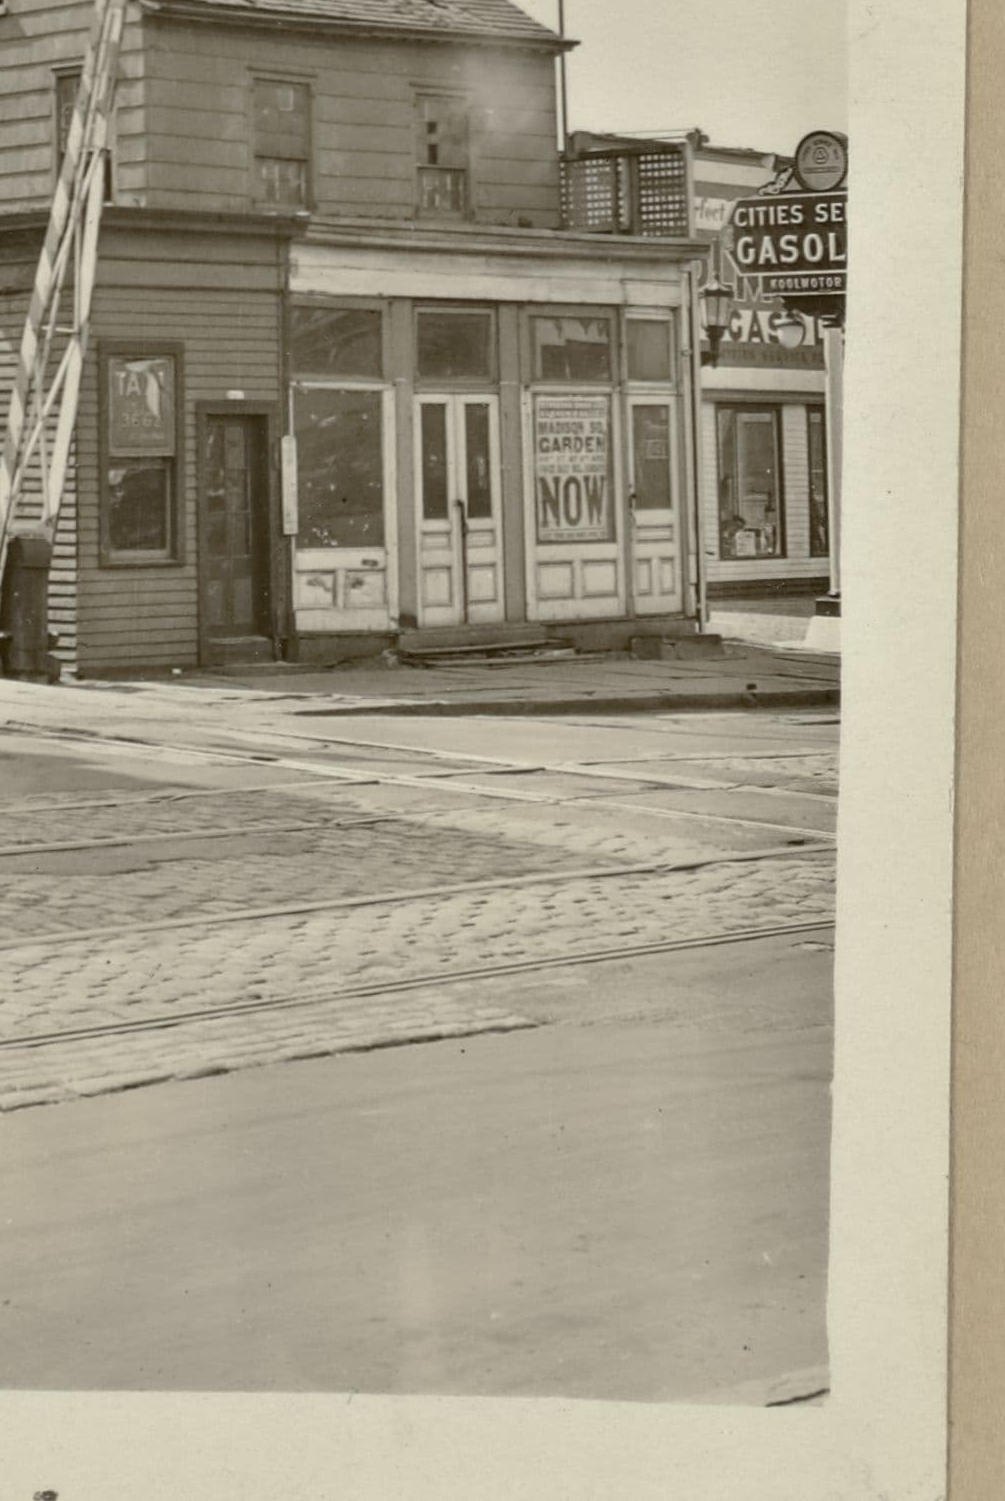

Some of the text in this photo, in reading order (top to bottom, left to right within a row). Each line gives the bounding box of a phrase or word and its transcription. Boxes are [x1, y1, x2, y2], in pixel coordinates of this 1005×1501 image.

[734, 204, 804, 227] CITIES
[736, 232, 846, 265] GASOL
[769, 276, 843, 290] KOOLMOTOR
[538, 421, 584, 435] MADISON
[539, 436, 605, 453] GARDEN
[539, 475, 606, 527] NOW
